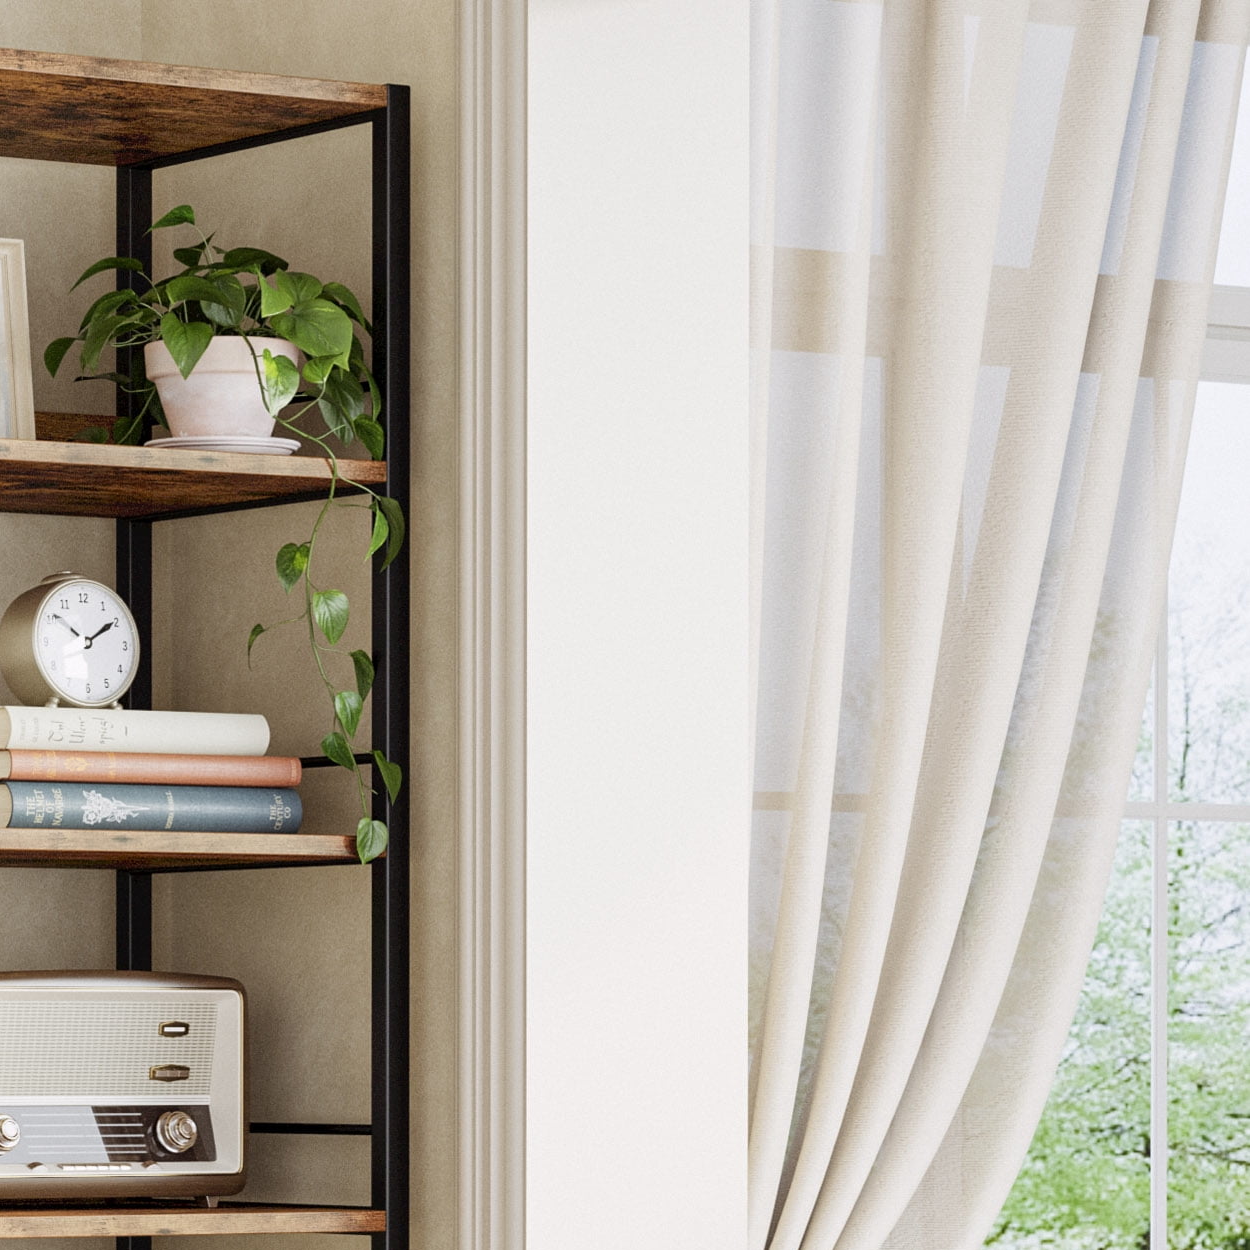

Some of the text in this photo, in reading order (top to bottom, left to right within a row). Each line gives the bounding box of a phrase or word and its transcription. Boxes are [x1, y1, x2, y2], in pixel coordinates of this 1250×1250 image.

[78, 593, 88, 604] 12
[60, 599, 70, 610] 11
[100, 601, 106, 611] 1
[113, 617, 119, 628] 2
[122, 640, 128, 651] 3
[116, 664, 123, 673] 4
[85, 683, 91, 693] 6
[104, 678, 110, 689] 5
[26, 796, 36, 816] THE
[33, 789, 45, 824] HELMET
[45, 800, 54, 814] OF
[52, 788, 64, 826] NAVARRE
[273, 794, 283, 830] CENTURY
[284, 807, 291, 819] CO
